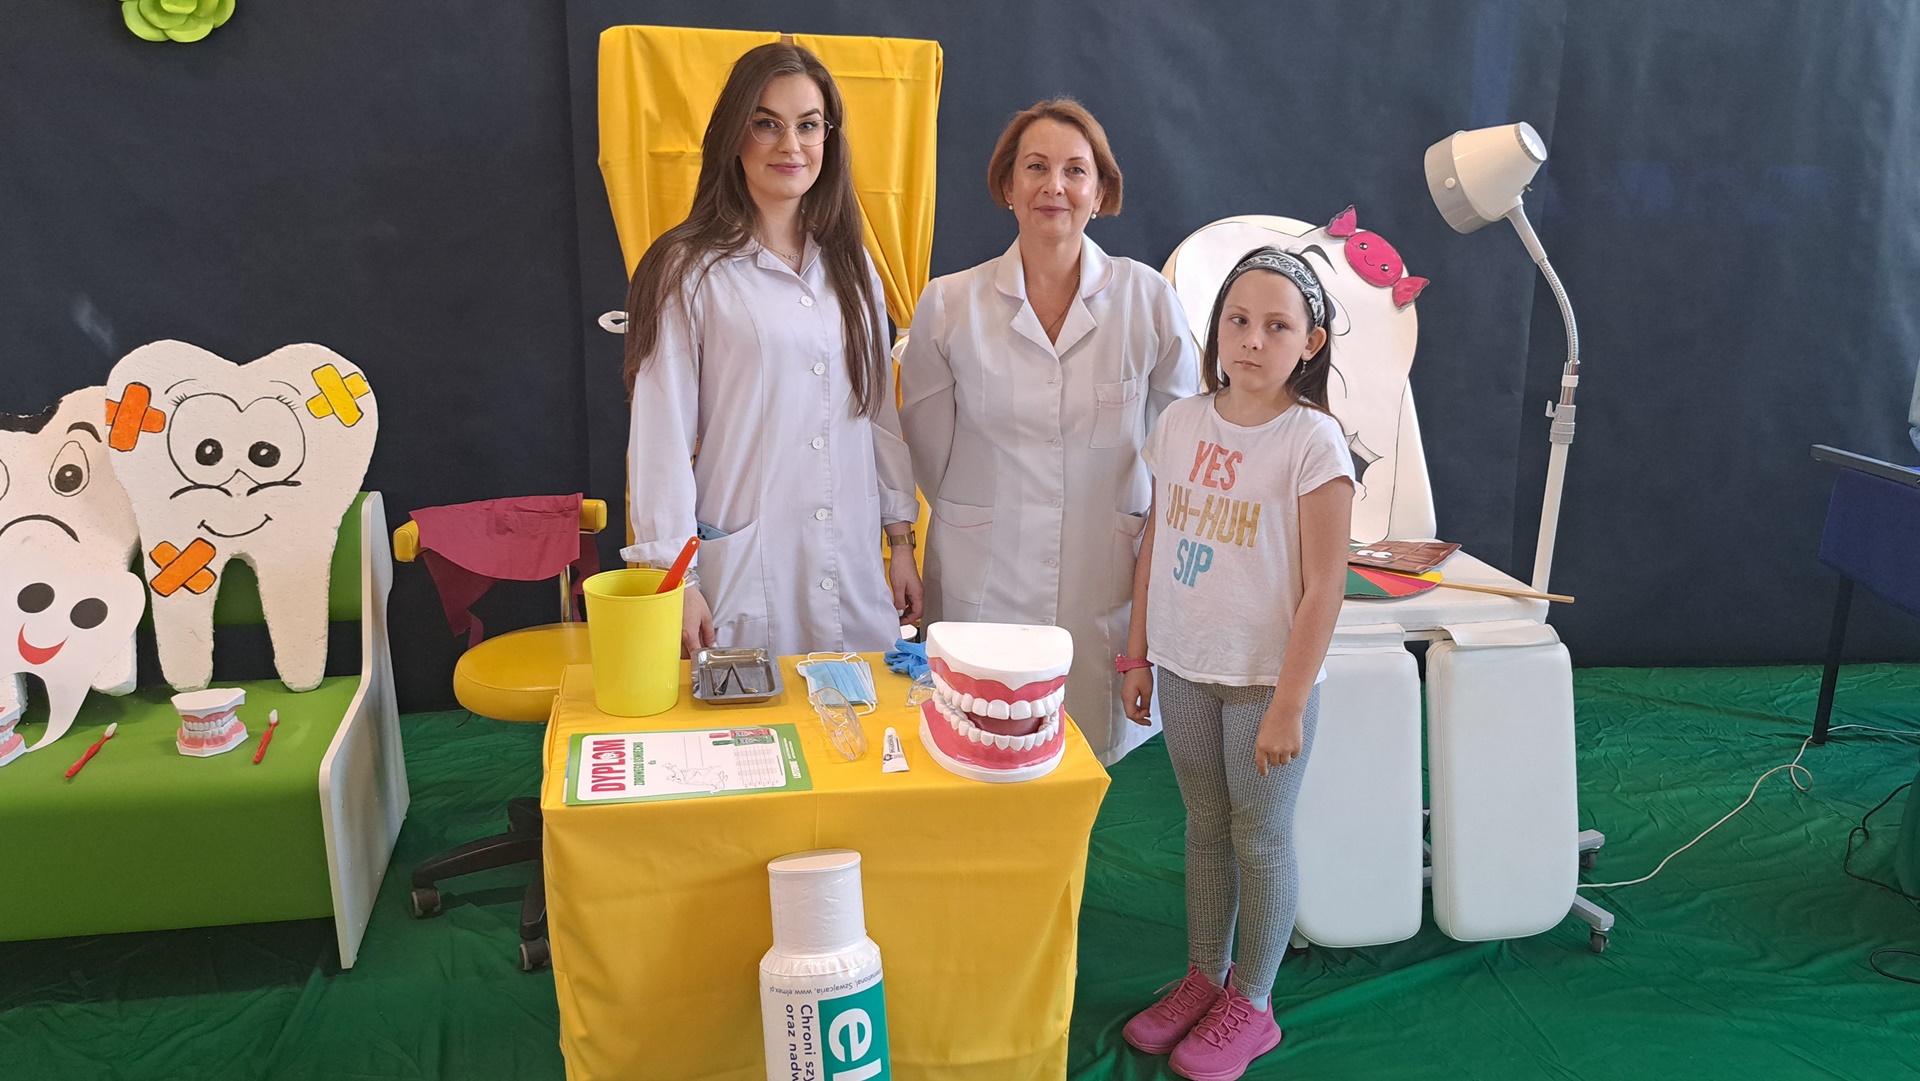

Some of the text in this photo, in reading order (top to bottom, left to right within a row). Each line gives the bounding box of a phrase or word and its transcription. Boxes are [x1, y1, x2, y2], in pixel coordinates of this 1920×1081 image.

[1188, 440, 1243, 491] YES
[1166, 483, 1261, 547] UH-HUH
[1173, 538, 1214, 588] SIP
[591, 738, 626, 792] DYPLOM
[770, 986, 812, 996] www.elmex.pl
[814, 982, 853, 995] Szwajcaria,
[786, 1004, 802, 1081] oraz nadw
[800, 1004, 816, 1081] Chroni szy
[828, 1007, 882, 1081] el
